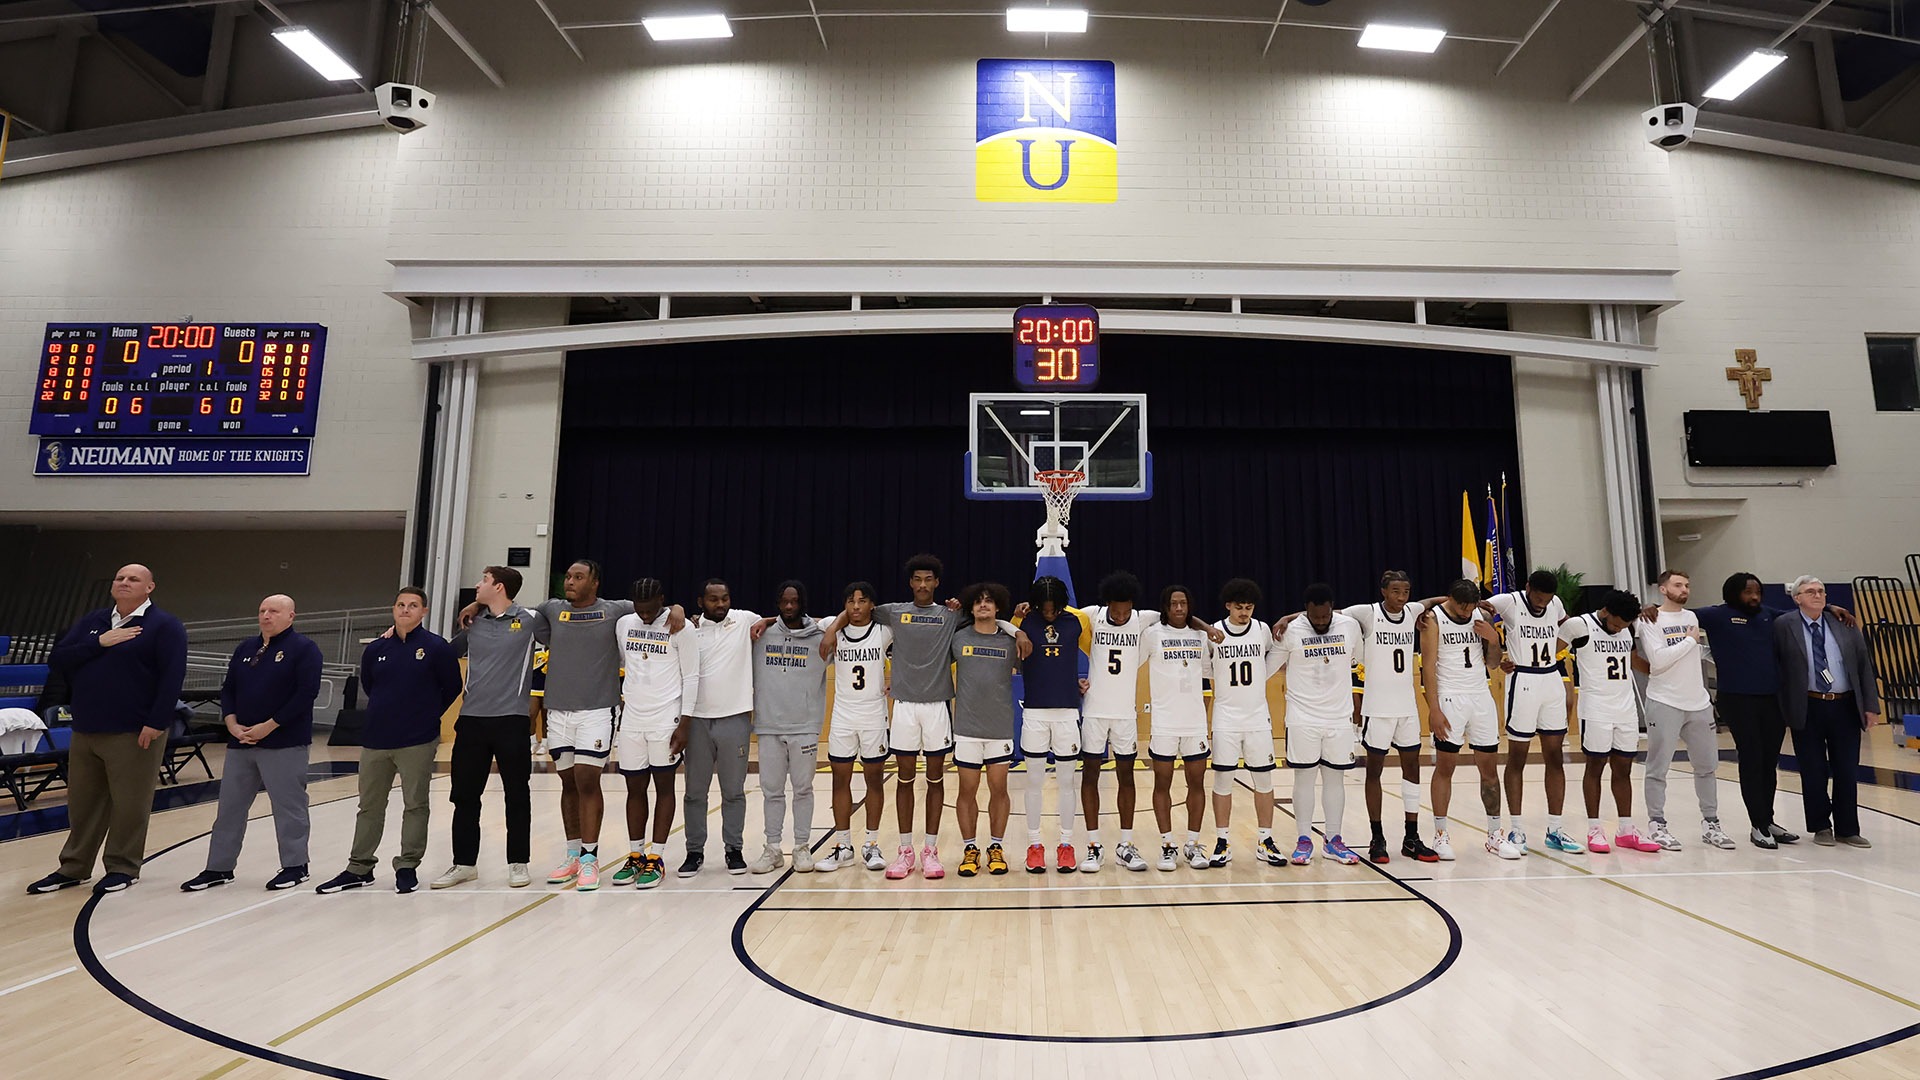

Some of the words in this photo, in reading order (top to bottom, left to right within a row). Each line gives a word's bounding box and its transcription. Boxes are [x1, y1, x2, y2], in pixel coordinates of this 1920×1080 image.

[1014, 72, 1078, 122] N
[1016, 140, 1076, 190] U
[112, 326, 138, 338] Home
[148, 326, 215, 348] 20:00
[224, 326, 256, 338] Guests
[1020, 320, 1093, 343] 20:00
[48, 344, 62, 353] 03
[70, 344, 78, 353] 0
[87, 344, 95, 353] 0
[123, 340, 140, 362] 0
[239, 340, 254, 362] 0
[264, 344, 277, 354] 02
[286, 344, 294, 354] 0
[302, 344, 310, 354] 0
[68, 356, 76, 365] 0
[85, 356, 92, 365] 0
[207, 360, 212, 375] 1
[262, 356, 276, 365] 04
[284, 356, 292, 365] 0
[300, 356, 308, 365] 0
[1037, 348, 1078, 380] 30
[66, 368, 74, 376] 0
[84, 368, 91, 376] 0
[162, 364, 192, 375] period
[262, 368, 274, 376] 05
[283, 368, 290, 376] 0
[299, 368, 306, 376] 0
[43, 379, 56, 388] 21
[65, 379, 72, 388] 0
[82, 379, 89, 388] 0
[102, 382, 124, 391] fouls
[160, 381, 190, 392] player
[226, 382, 248, 391] fouls
[260, 379, 272, 388] 23
[282, 379, 288, 388] 0
[298, 379, 304, 388] 0
[41, 391, 54, 400] 22
[63, 391, 71, 400] 0
[80, 391, 88, 400] 0
[259, 391, 270, 400] 32
[280, 391, 288, 400] 0
[296, 391, 304, 400] 0
[105, 398, 118, 414] 0
[130, 398, 142, 414] 6
[200, 398, 212, 414] 6
[230, 398, 242, 414] 0
[98, 420, 116, 429] won
[158, 420, 182, 431] game
[222, 420, 240, 429] won
[70, 446, 176, 466] NEUMANN
[178, 450, 210, 462] HOME
[212, 450, 226, 462] OF
[230, 450, 252, 462] THE
[254, 450, 304, 462] KNIGHTS
[1095, 632, 1138, 646] NEUMANN
[626, 642, 668, 654] BASKETBALL
[838, 648, 880, 662] NEUMANN
[1218, 644, 1260, 658] NEUMANN
[1304, 646, 1346, 658] BASKETBALL
[1531, 642, 1551, 668] 14
[1108, 649, 1122, 674] 5
[1393, 648, 1404, 673] 0
[1463, 646, 1472, 668] 1
[1229, 660, 1252, 686] 10
[1606, 656, 1628, 680] 21
[852, 665, 865, 690] 3
